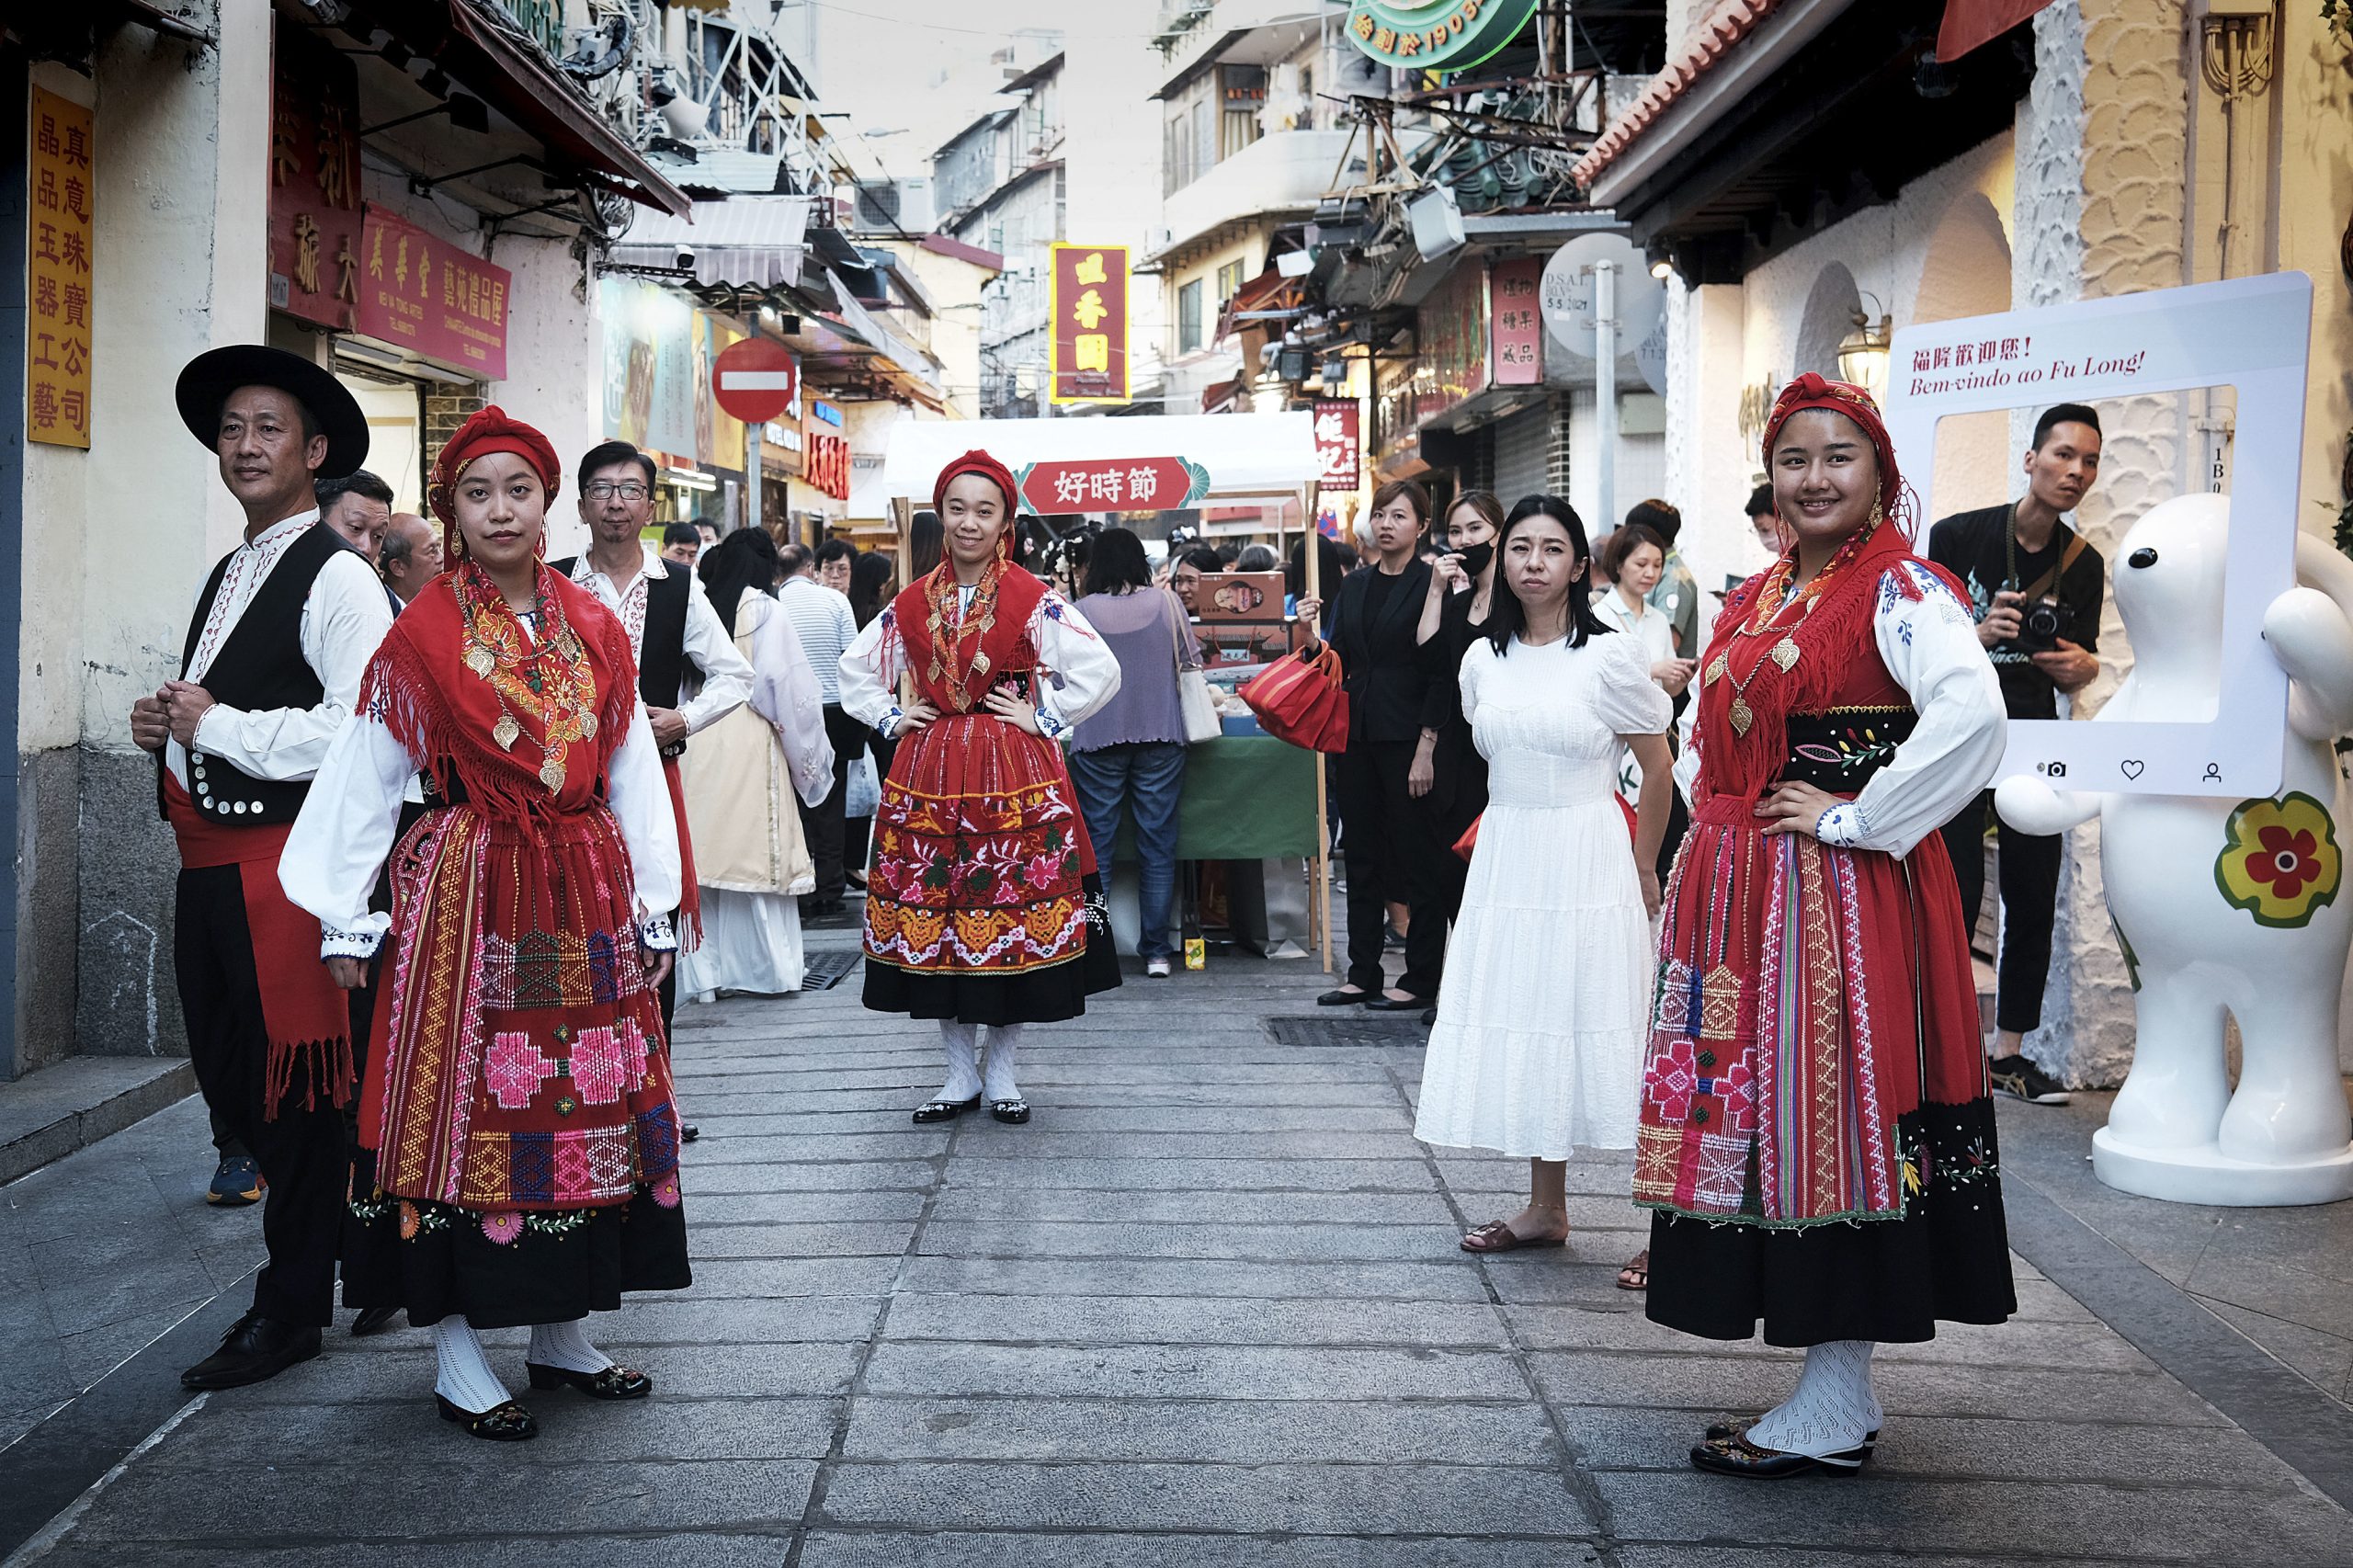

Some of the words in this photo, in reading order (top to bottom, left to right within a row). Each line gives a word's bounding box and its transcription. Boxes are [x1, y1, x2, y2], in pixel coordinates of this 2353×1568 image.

[33, 113, 60, 429] 晶品玉器工藝
[61, 125, 89, 431] 真意珠寶公司
[1909, 368, 2011, 396] Bem-vindo
[2017, 369, 2042, 383] ao
[2050, 360, 2076, 381] Fu
[2084, 350, 2145, 376] Long!
[1053, 467, 1157, 505] 好時節
